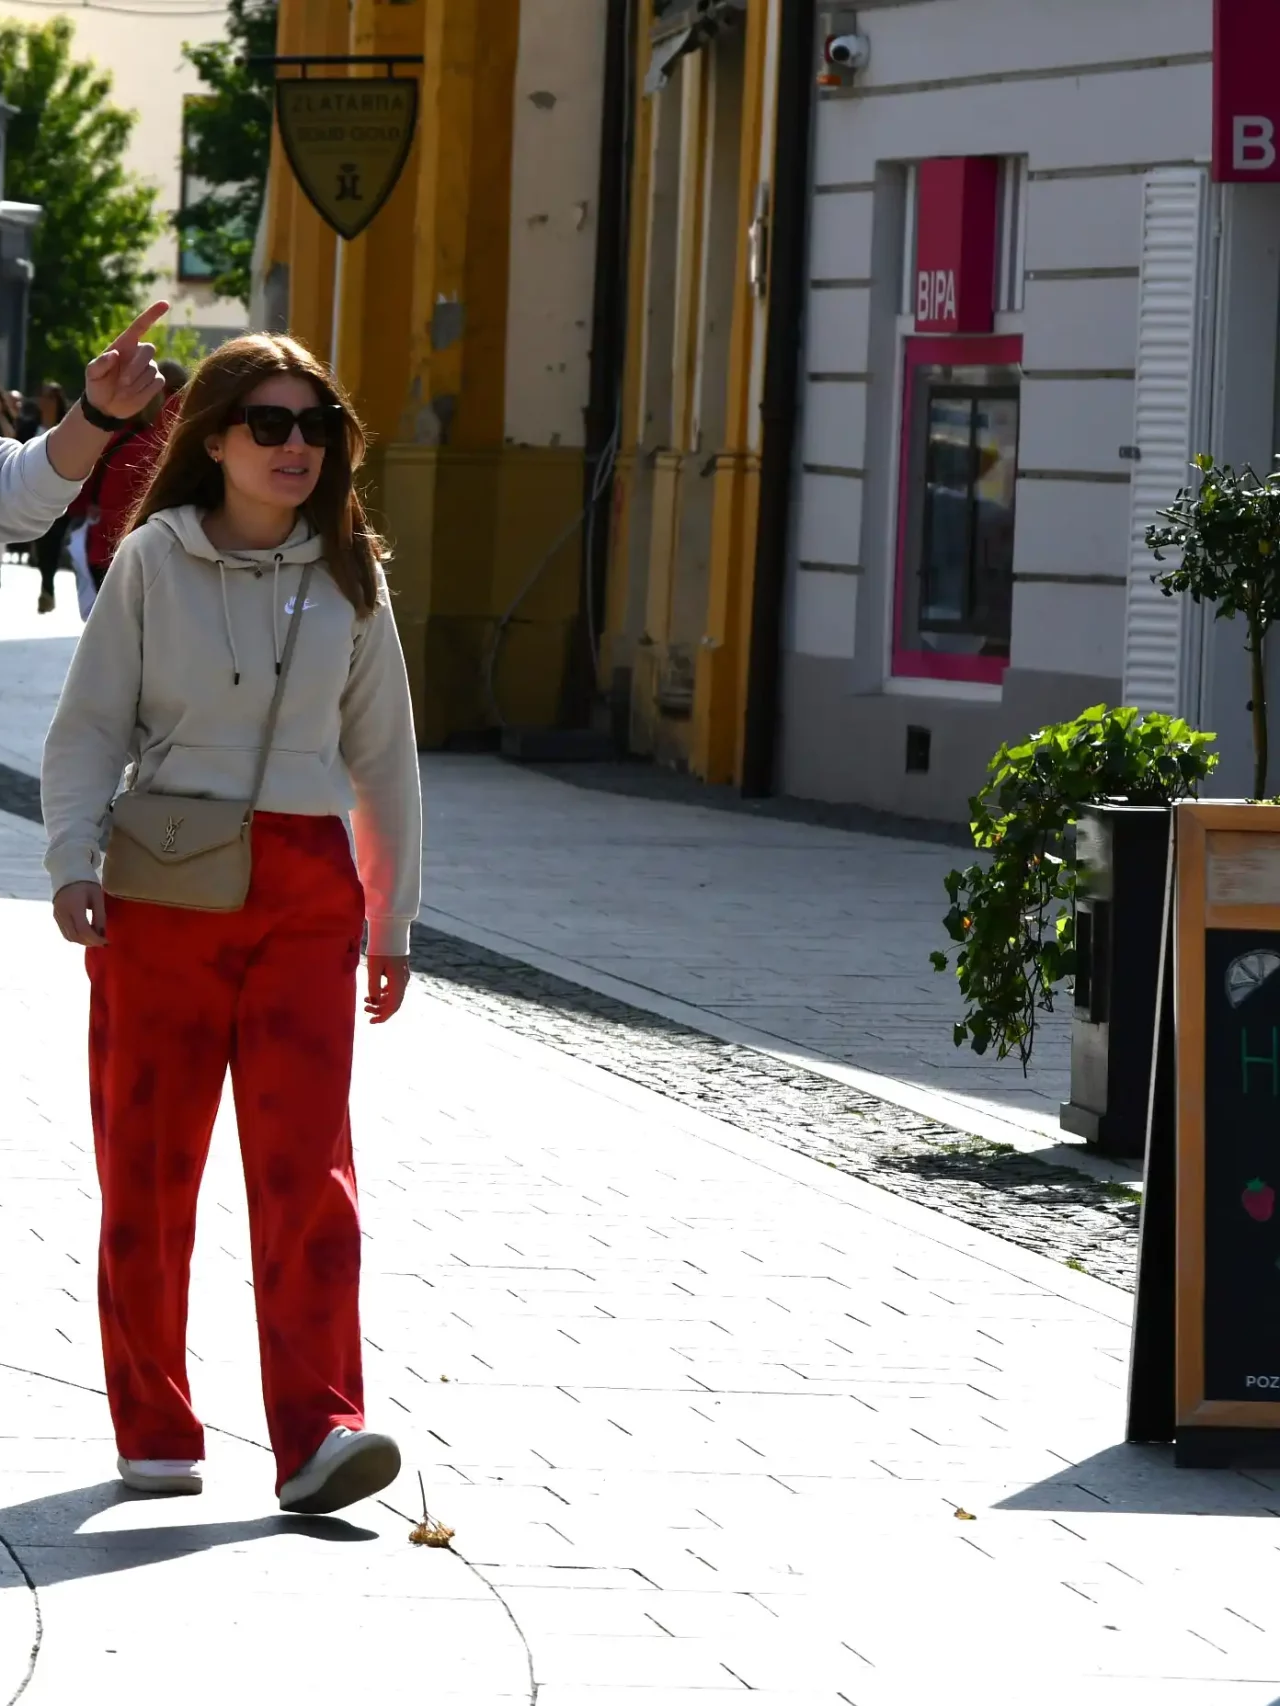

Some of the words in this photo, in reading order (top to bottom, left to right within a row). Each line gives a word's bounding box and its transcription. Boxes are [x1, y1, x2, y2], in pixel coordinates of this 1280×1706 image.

[1232, 115, 1277, 170] B
[917, 268, 957, 322] BIPA
[1241, 1026, 1278, 1096] H
[1245, 1375, 1280, 1389] POZ
